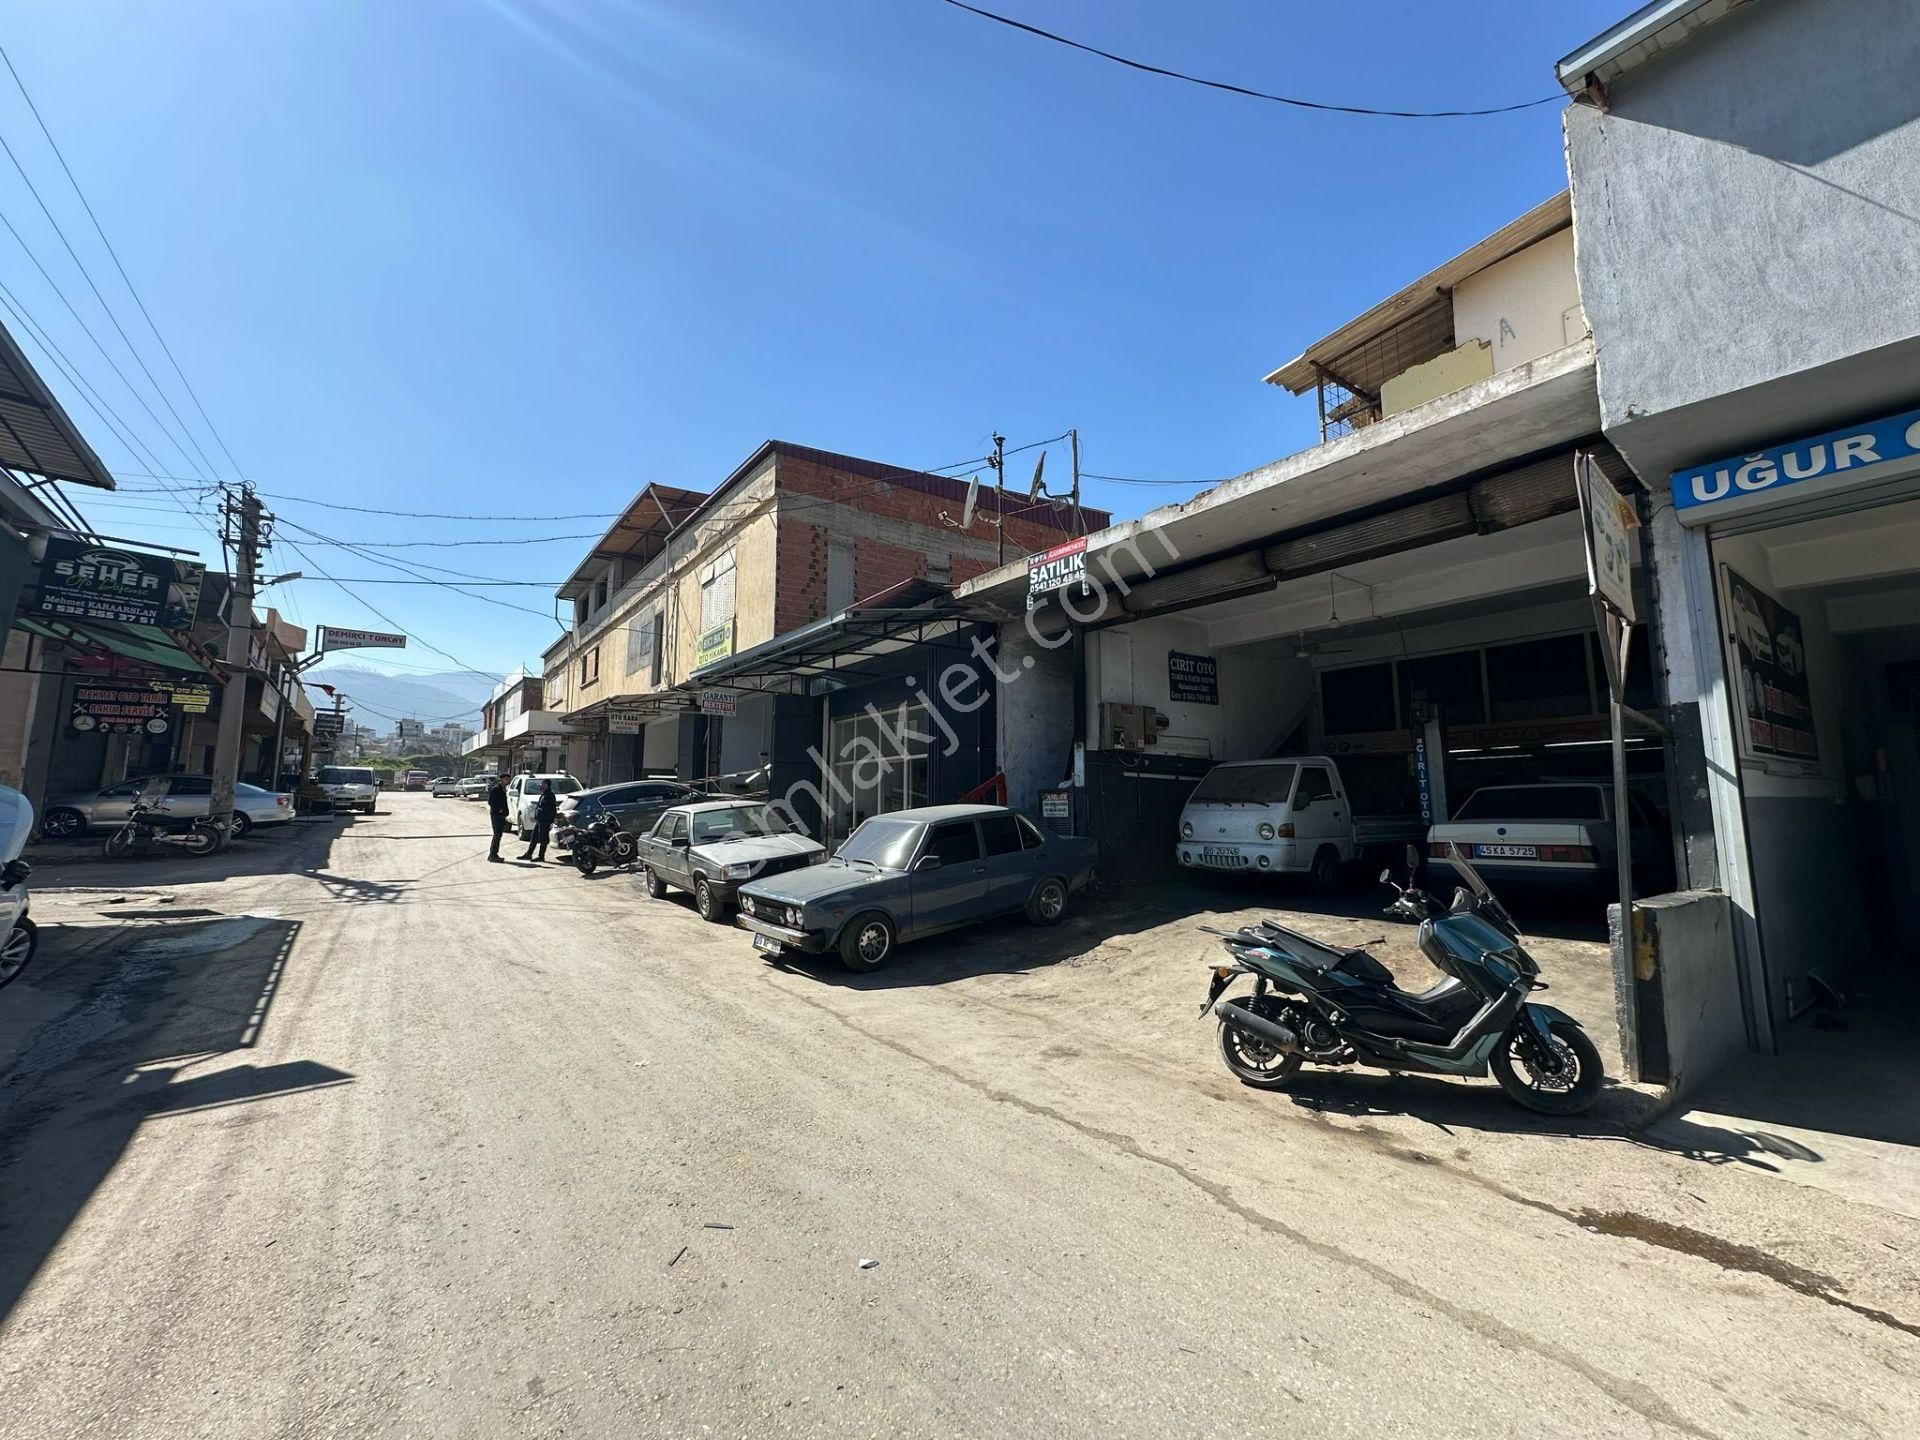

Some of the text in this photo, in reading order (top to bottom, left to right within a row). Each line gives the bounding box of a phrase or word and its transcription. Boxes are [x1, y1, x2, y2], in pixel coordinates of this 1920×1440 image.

[1691, 434, 1882, 502] UĞUR
[54, 561, 160, 590] SEHER
[1030, 552, 1085, 584] SATILIK
[1030, 582, 1047, 593] 0541
[1048, 577, 1061, 589] 120
[44, 595, 157, 617] Mehmet KARAARSLAN
[56, 605, 84, 615] 532
[87, 609, 114, 619] 355
[118, 612, 137, 622] 37
[118, 691, 140, 702] OTO
